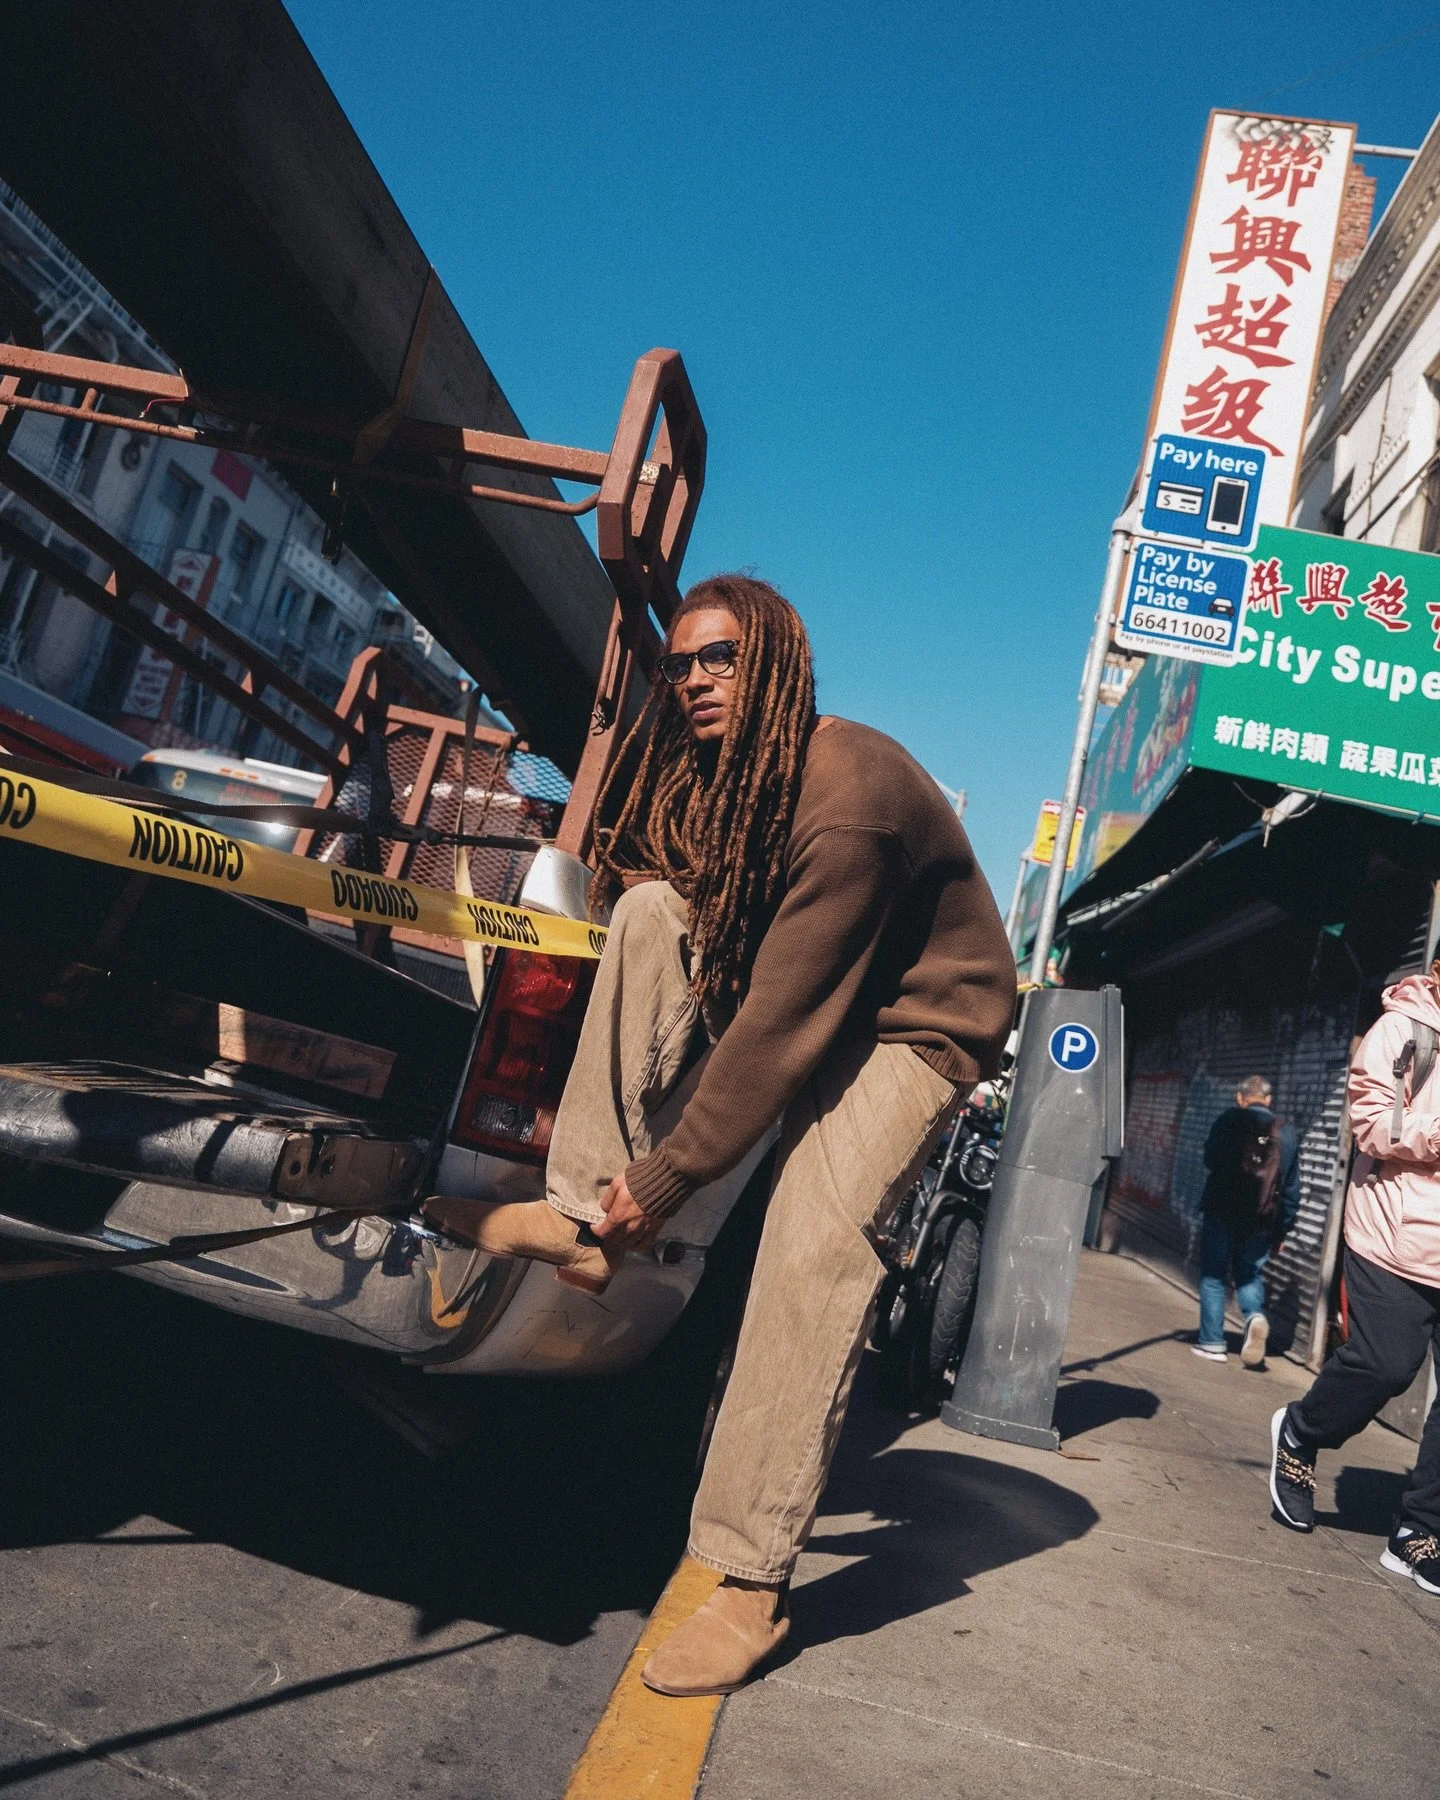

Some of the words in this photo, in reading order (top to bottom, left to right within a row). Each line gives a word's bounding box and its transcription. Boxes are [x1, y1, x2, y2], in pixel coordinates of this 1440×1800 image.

[1160, 442, 1203, 470] Pay
[1205, 449, 1258, 476] here
[1141, 545, 1181, 572] Pay
[1186, 552, 1215, 578] by
[1138, 565, 1217, 595] License
[1134, 584, 1189, 610] Plate
[1133, 612, 1226, 642] 66411002
[1120, 632, 1133, 641] Pay
[1135, 635, 1144, 643] by
[1146, 637, 1171, 647] phone
[1192, 647, 1233, 658] paystation
[1236, 626, 1322, 685] City
[1214, 715, 1329, 765] 新鮮肉類
[129, 815, 243, 882] CAUTION
[331, 869, 418, 922] CUIDADO
[467, 903, 540, 946] CAUTION
[1061, 1030, 1087, 1062] P
